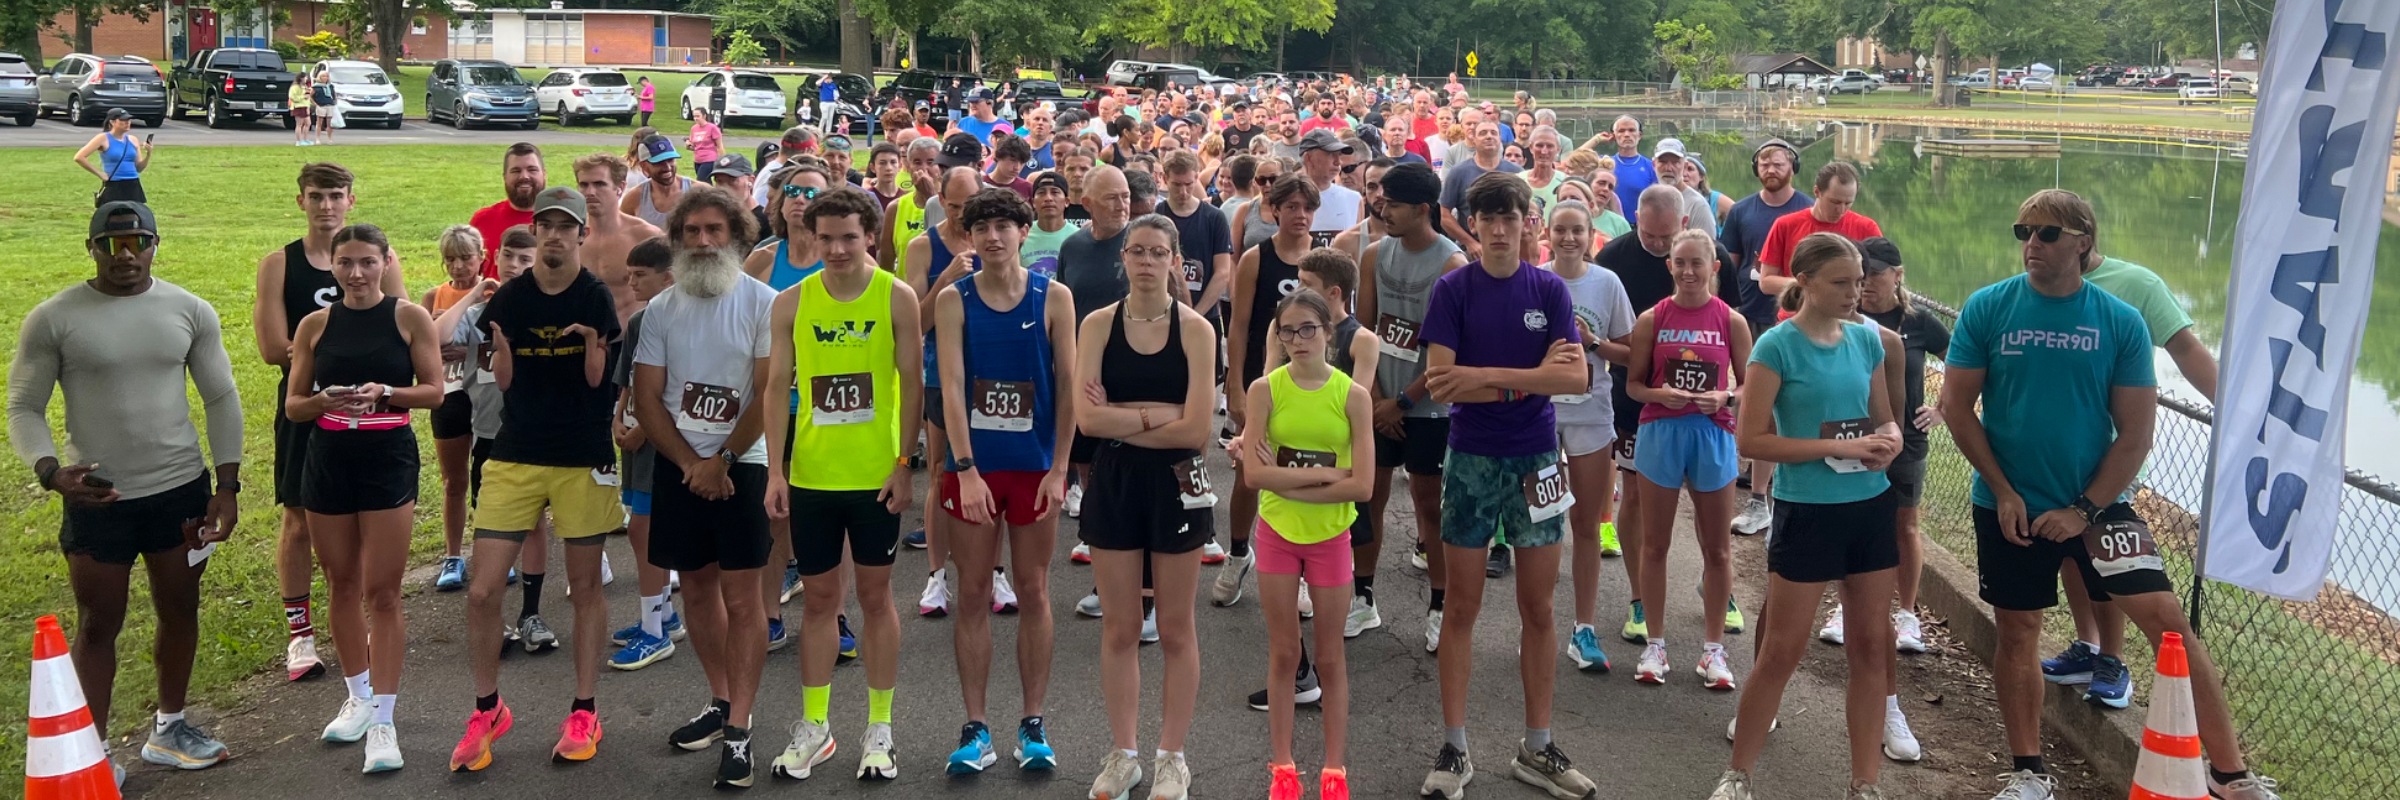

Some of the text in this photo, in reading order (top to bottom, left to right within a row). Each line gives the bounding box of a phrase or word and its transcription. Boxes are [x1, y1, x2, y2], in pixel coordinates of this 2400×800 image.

[2244, 0, 2387, 574] START
[1386, 323, 1414, 347] 577
[2008, 329, 2093, 352] UPPER90
[1674, 368, 1707, 392] 552
[692, 395, 728, 420] 402
[824, 384, 860, 409] 413
[985, 391, 1021, 415] 533
[1535, 473, 1564, 505] 802
[2100, 531, 2141, 559] 987
